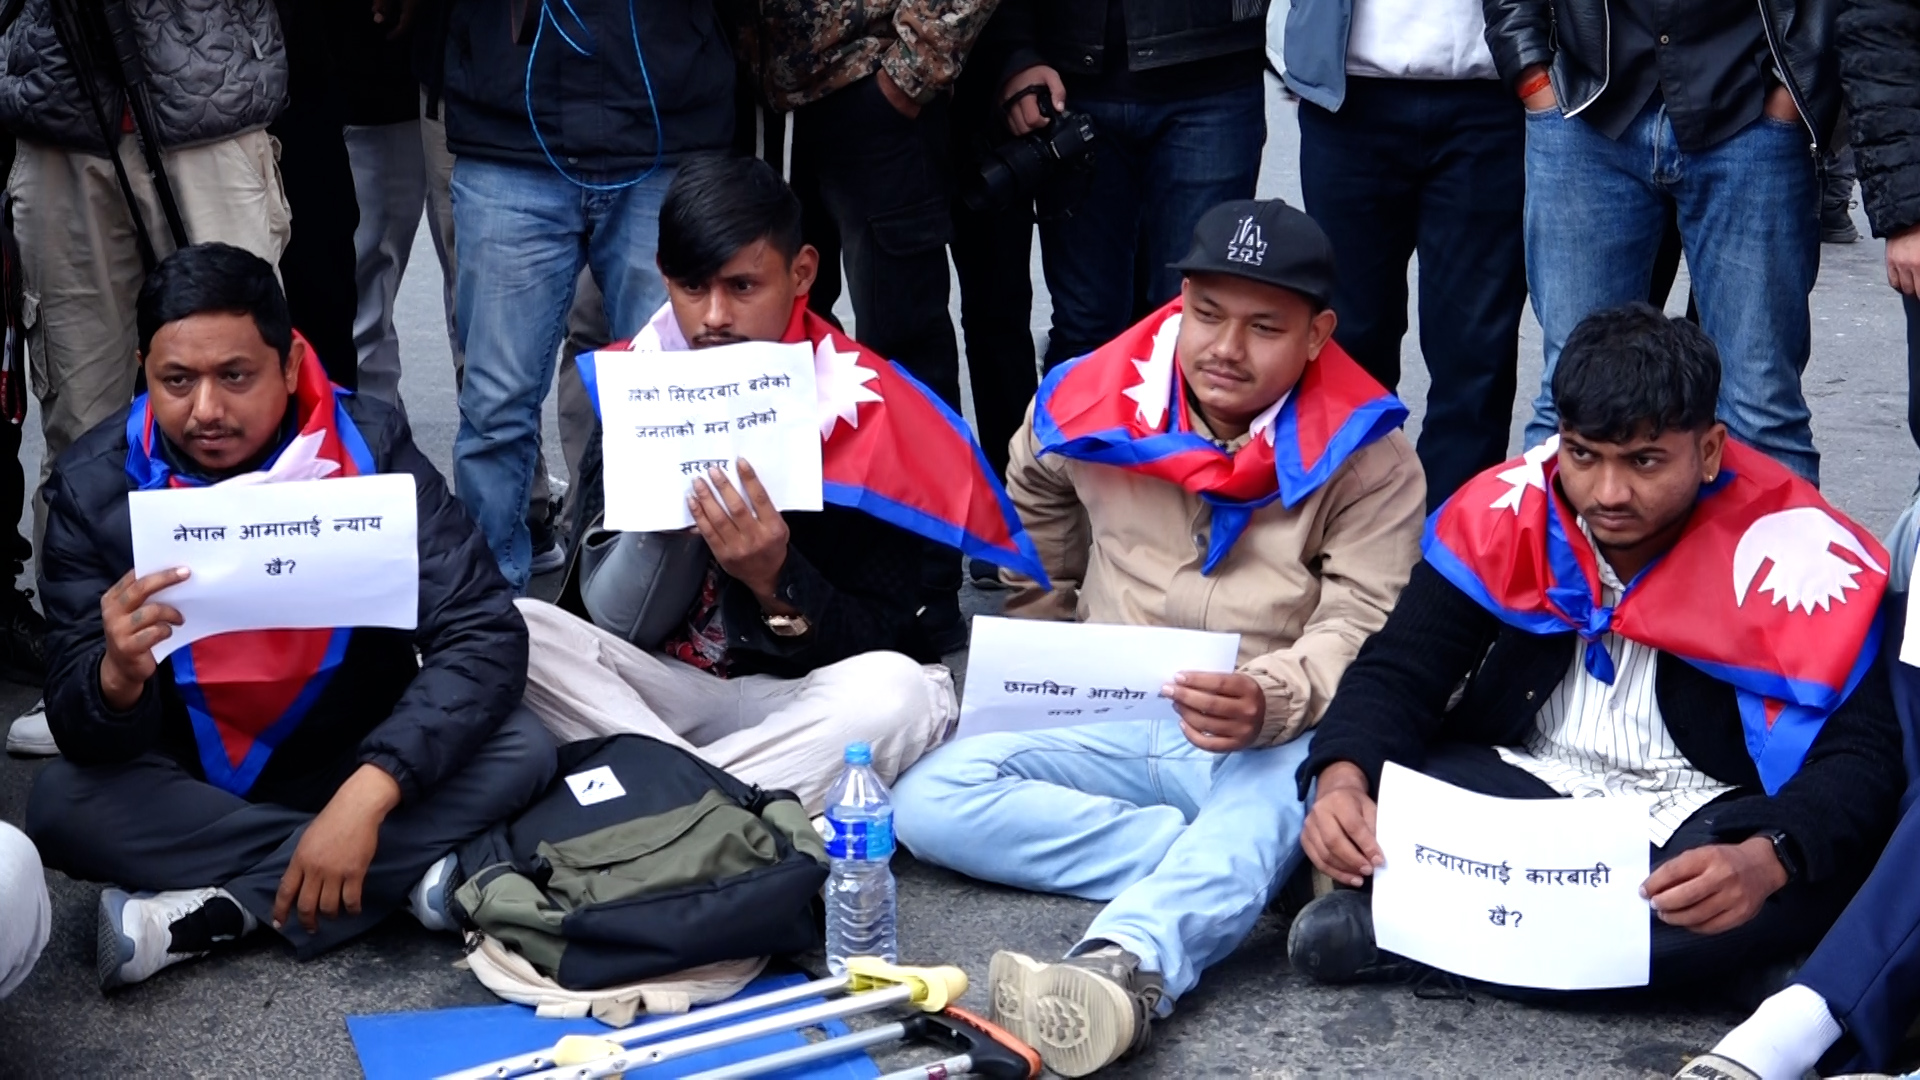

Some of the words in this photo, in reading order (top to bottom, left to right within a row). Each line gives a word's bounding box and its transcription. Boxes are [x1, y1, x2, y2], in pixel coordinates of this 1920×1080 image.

[1227, 215, 1268, 266] LA
[748, 373, 791, 391] बलेको
[635, 420, 695, 439] जनताको
[703, 420, 730, 434] मन
[173, 524, 228, 542] नेपाल
[239, 515, 322, 540] आमालाई
[332, 516, 383, 532] न्याय
[264, 557, 296, 576] खै?
[1004, 680, 1077, 697] छानबिन
[1087, 687, 1147, 700] आयोग
[1415, 844, 1513, 885] हत्यारालाई
[1525, 861, 1611, 888] कारबाही
[1488, 904, 1523, 928] खै?
